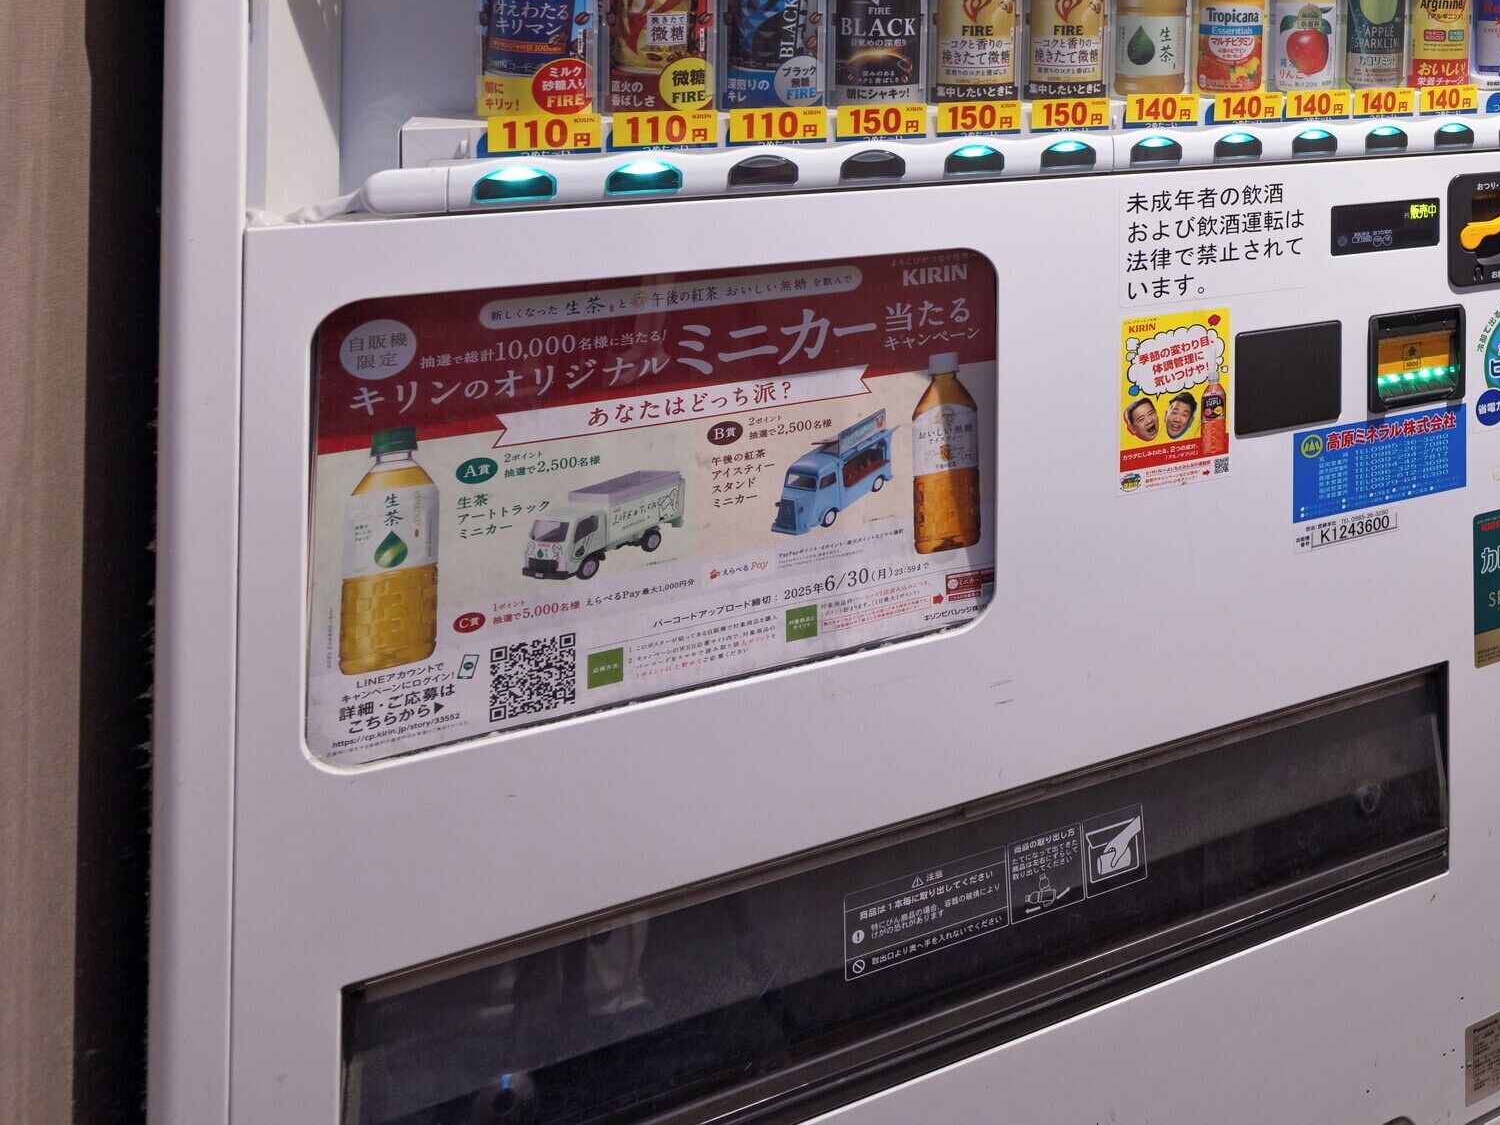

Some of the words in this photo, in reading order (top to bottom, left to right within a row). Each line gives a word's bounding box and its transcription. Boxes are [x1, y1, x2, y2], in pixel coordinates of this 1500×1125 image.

[1205, 7, 1260, 25] Tropicana
[651, 26, 685, 43] 微糖
[840, 17, 916, 38] BLACK
[1211, 26, 1253, 35] Essentials
[549, 65, 582, 77] ミルク
[671, 68, 706, 87] 微糖
[546, 92, 585, 108] FIRE
[672, 90, 706, 104] FIRE
[786, 86, 817, 100] FIRE
[1294, 92, 1344, 116] 140円
[1361, 91, 1408, 113] 140円
[1427, 87, 1472, 109] 140円
[947, 104, 1013, 131] 150円
[1042, 101, 1103, 127] 150円
[1135, 97, 1191, 120] 140円
[1222, 95, 1275, 119] 140円
[626, 114, 708, 145] 110円
[742, 111, 818, 140] 110円
[849, 107, 920, 134] 150円
[502, 117, 591, 149] 110円
[1126, 183, 1284, 214] 未成年者の飲酒
[1409, 203, 1437, 220] 販売中
[1127, 209, 1305, 244] および飲酒運転は
[1126, 238, 1303, 273] 法律で禁止されて
[1127, 274, 1205, 301] います。
[348, 332, 408, 352] 自販機
[676, 308, 878, 375] ミニカー
[885, 297, 970, 333] 当たる
[884, 327, 982, 352] キャンペーン
[356, 352, 398, 370] 限定
[1152, 351, 1205, 376] 体調管理に
[1326, 411, 1457, 452] 高原ミネラル株式会社
[711, 449, 766, 466] 午後の紅茶
[711, 462, 776, 480] アイスティー
[712, 477, 757, 494] スタンド
[713, 494, 758, 508] ミニカー
[457, 500, 550, 525] アートトラック
[1350, 509, 1389, 522] 0985-36-3280
[458, 525, 513, 539] ミニカー
[1320, 516, 1390, 544] K1243600
[356, 662, 445, 689] LINEアカウントで
[1013, 828, 1075, 854] 商品の取り出し方
[925, 870, 943, 882] 注意
